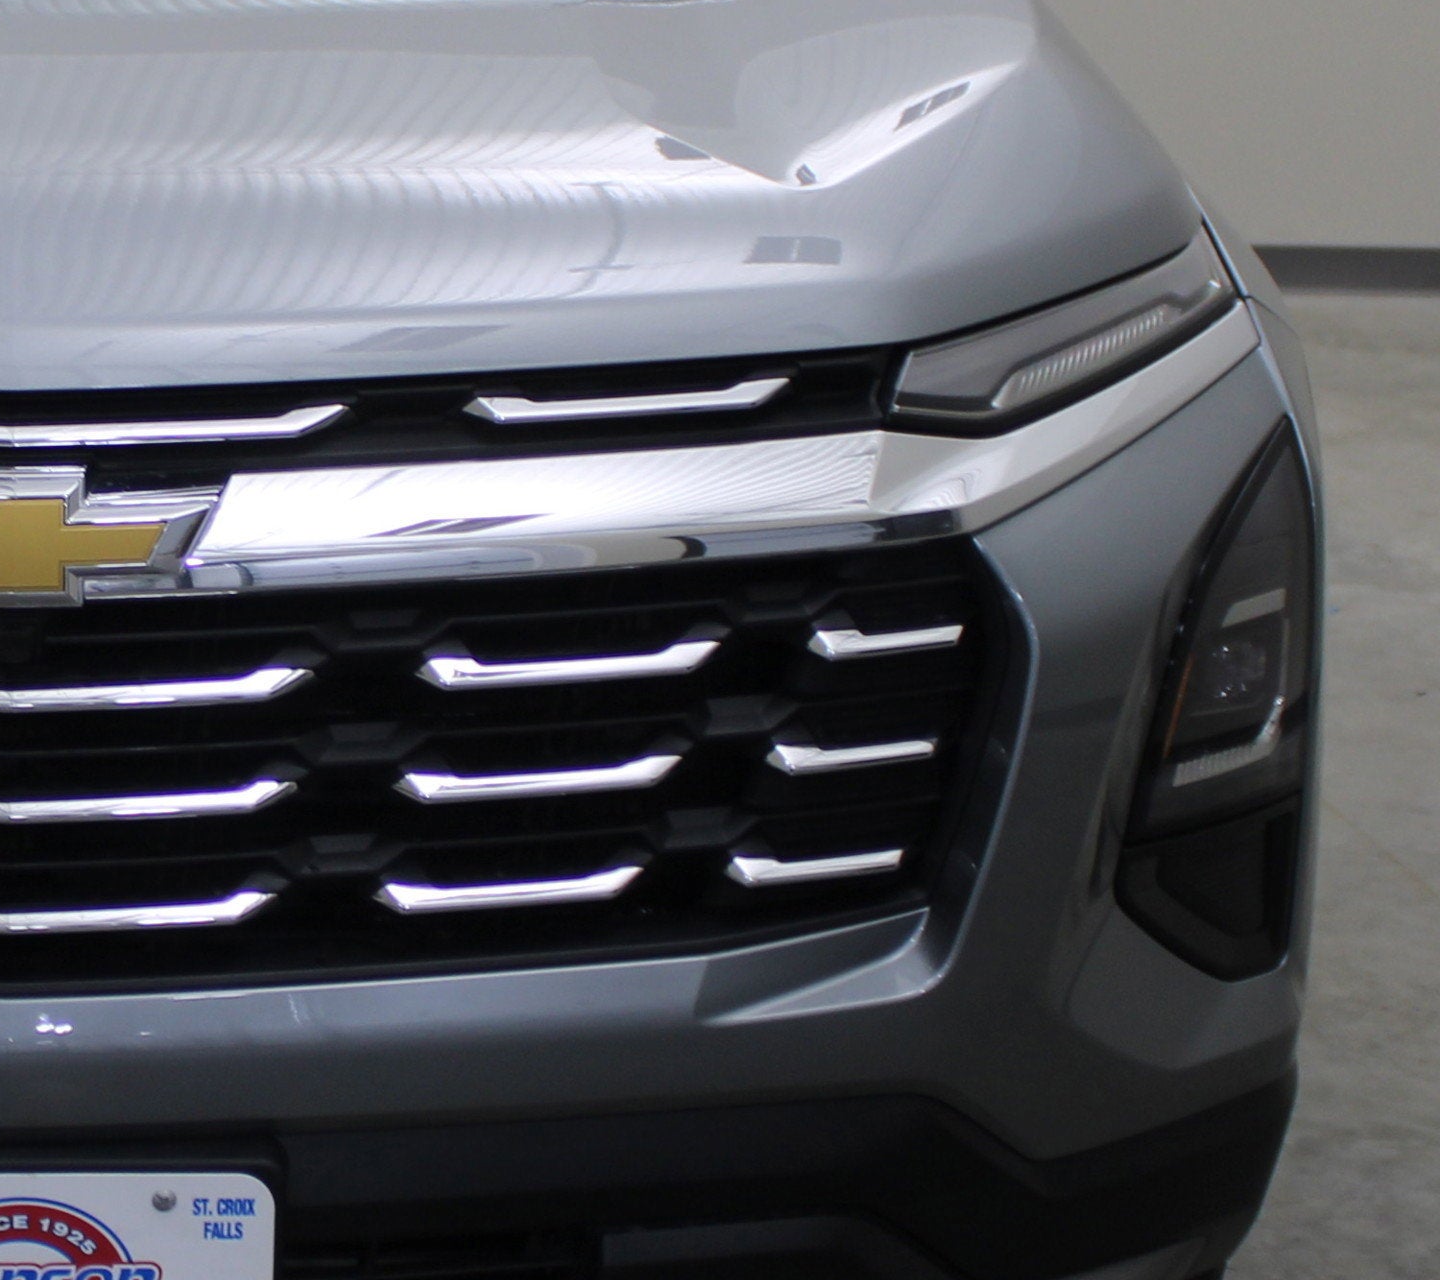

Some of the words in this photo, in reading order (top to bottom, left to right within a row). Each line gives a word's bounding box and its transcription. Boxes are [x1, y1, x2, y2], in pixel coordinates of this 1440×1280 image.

[193, 1198, 212, 1215] ST.
[217, 1198, 255, 1215] CROIX
[39, 1217, 97, 1255] 1925
[203, 1222, 243, 1239] FALLS
